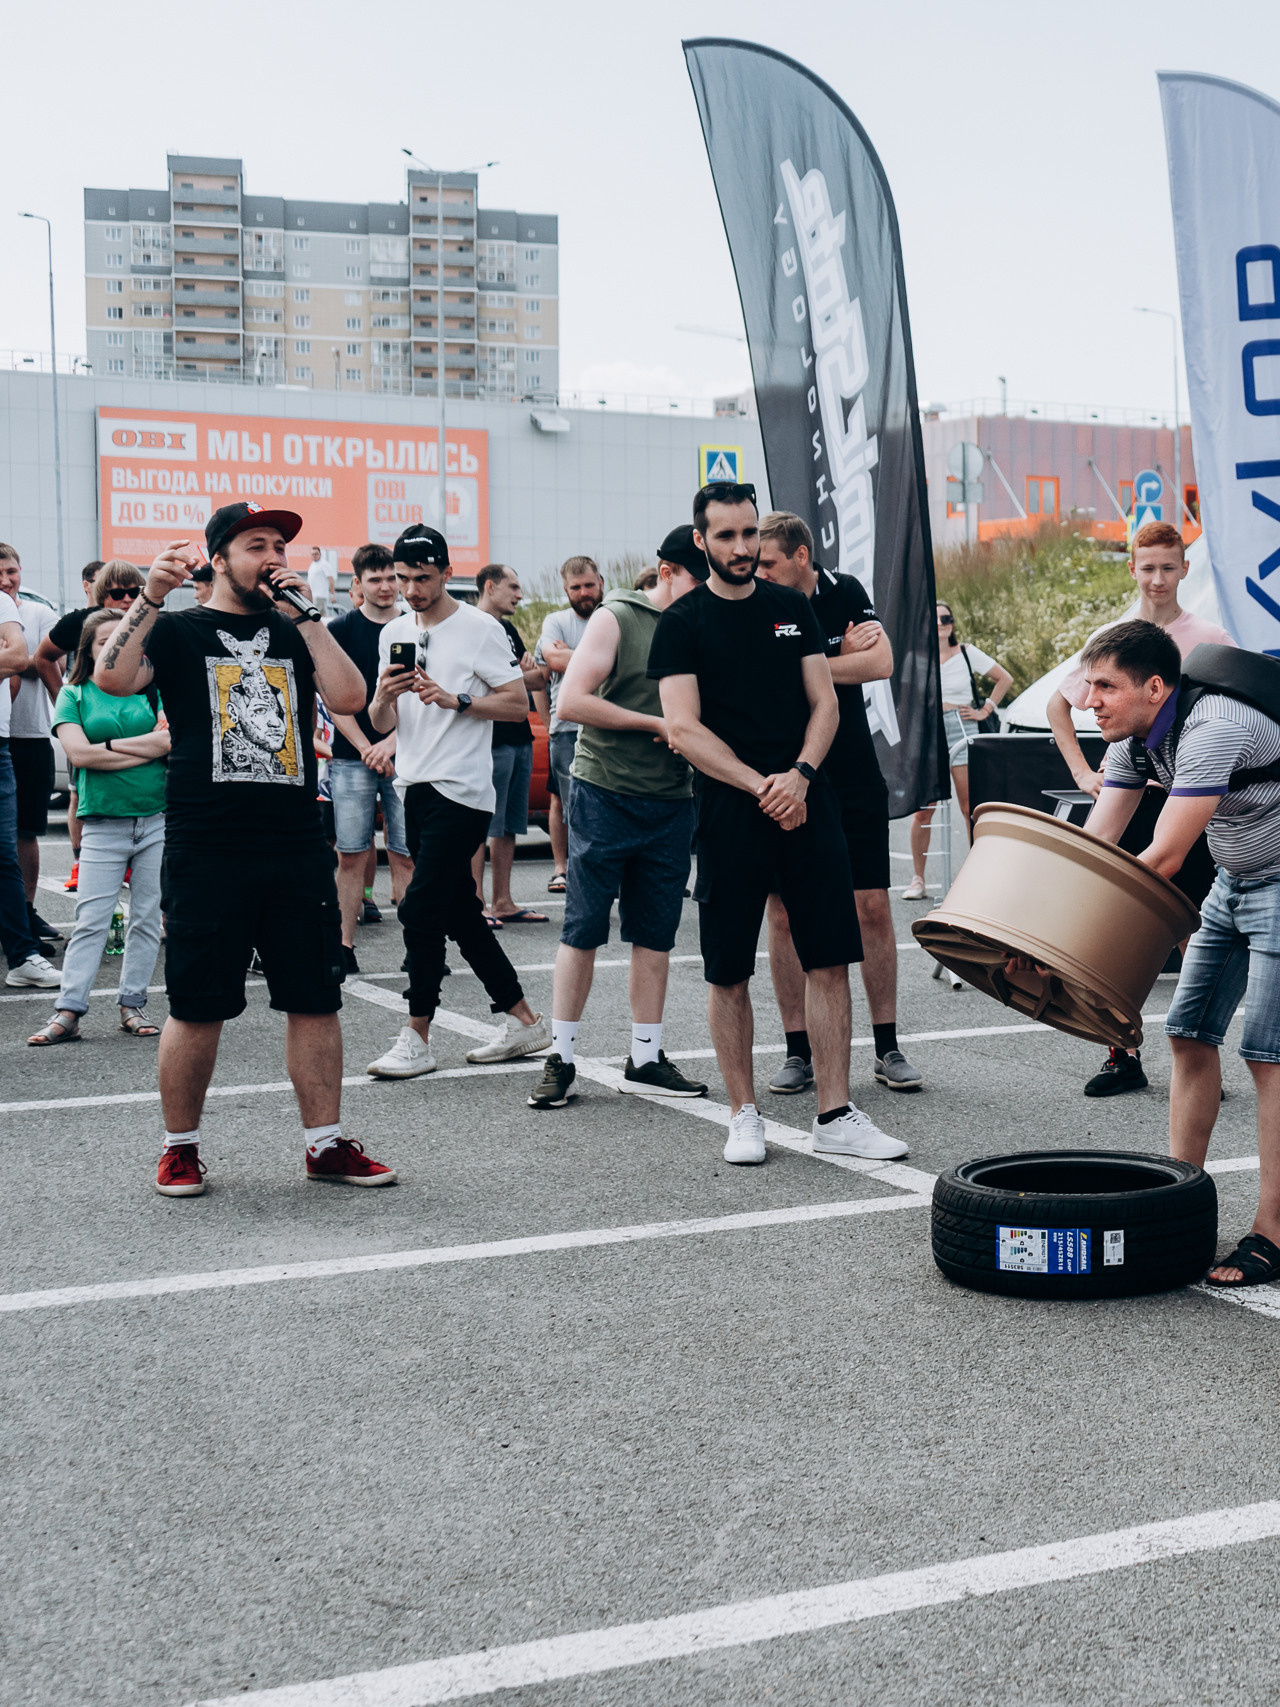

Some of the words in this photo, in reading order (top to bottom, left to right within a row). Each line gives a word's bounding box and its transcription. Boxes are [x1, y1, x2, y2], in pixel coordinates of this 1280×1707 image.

[112, 429, 186, 450] OBI
[207, 429, 271, 463] МЫ
[283, 433, 479, 474] ОТКРЫЛИСЬ
[112, 467, 199, 494] ВЫГОДА
[204, 472, 232, 494] НА
[237, 473, 332, 498] ПОКУПКИ
[374, 479, 405, 500] OBI
[118, 501, 146, 524] ДО
[153, 502, 178, 523] 50
[375, 503, 422, 523] CLUB
